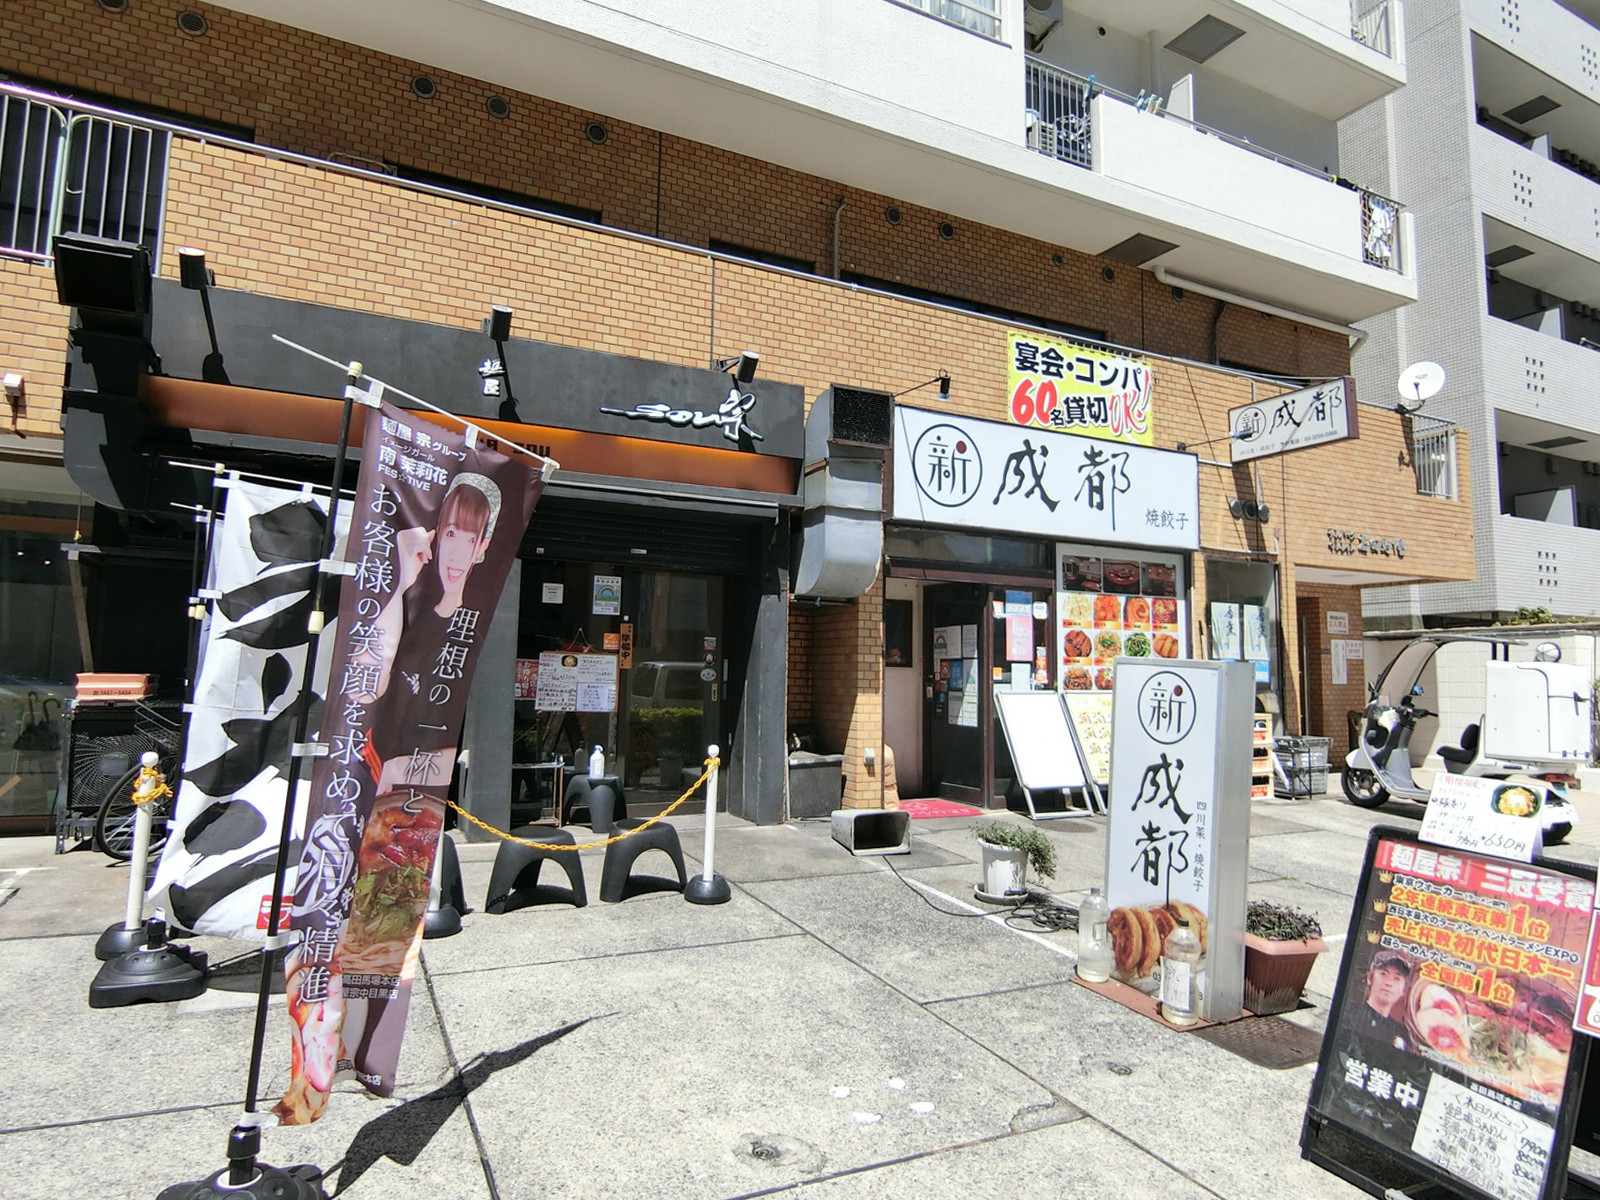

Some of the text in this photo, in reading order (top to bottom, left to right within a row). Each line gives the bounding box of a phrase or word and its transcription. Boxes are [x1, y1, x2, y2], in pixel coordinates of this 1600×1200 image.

[382, 416, 413, 442] 麺屋
[1269, 386, 1342, 435] 成都
[379, 445, 449, 486] 南 茉莉花
[382, 437, 436, 462] イメージガール
[993, 438, 1130, 532] 成都
[1145, 508, 1189, 531] 焼餃子
[402, 606, 481, 814] 理想の一杯と
[1131, 752, 1194, 909] 成都
[1193, 800, 1208, 893] 四川菜・焼餃子
[1390, 886, 1549, 942] 2年連続東京第1位
[1384, 916, 1575, 981] 売上杯数初代日本一
[1419, 960, 1516, 1007] 全国第1位
[1345, 1057, 1421, 1109] 営業中
